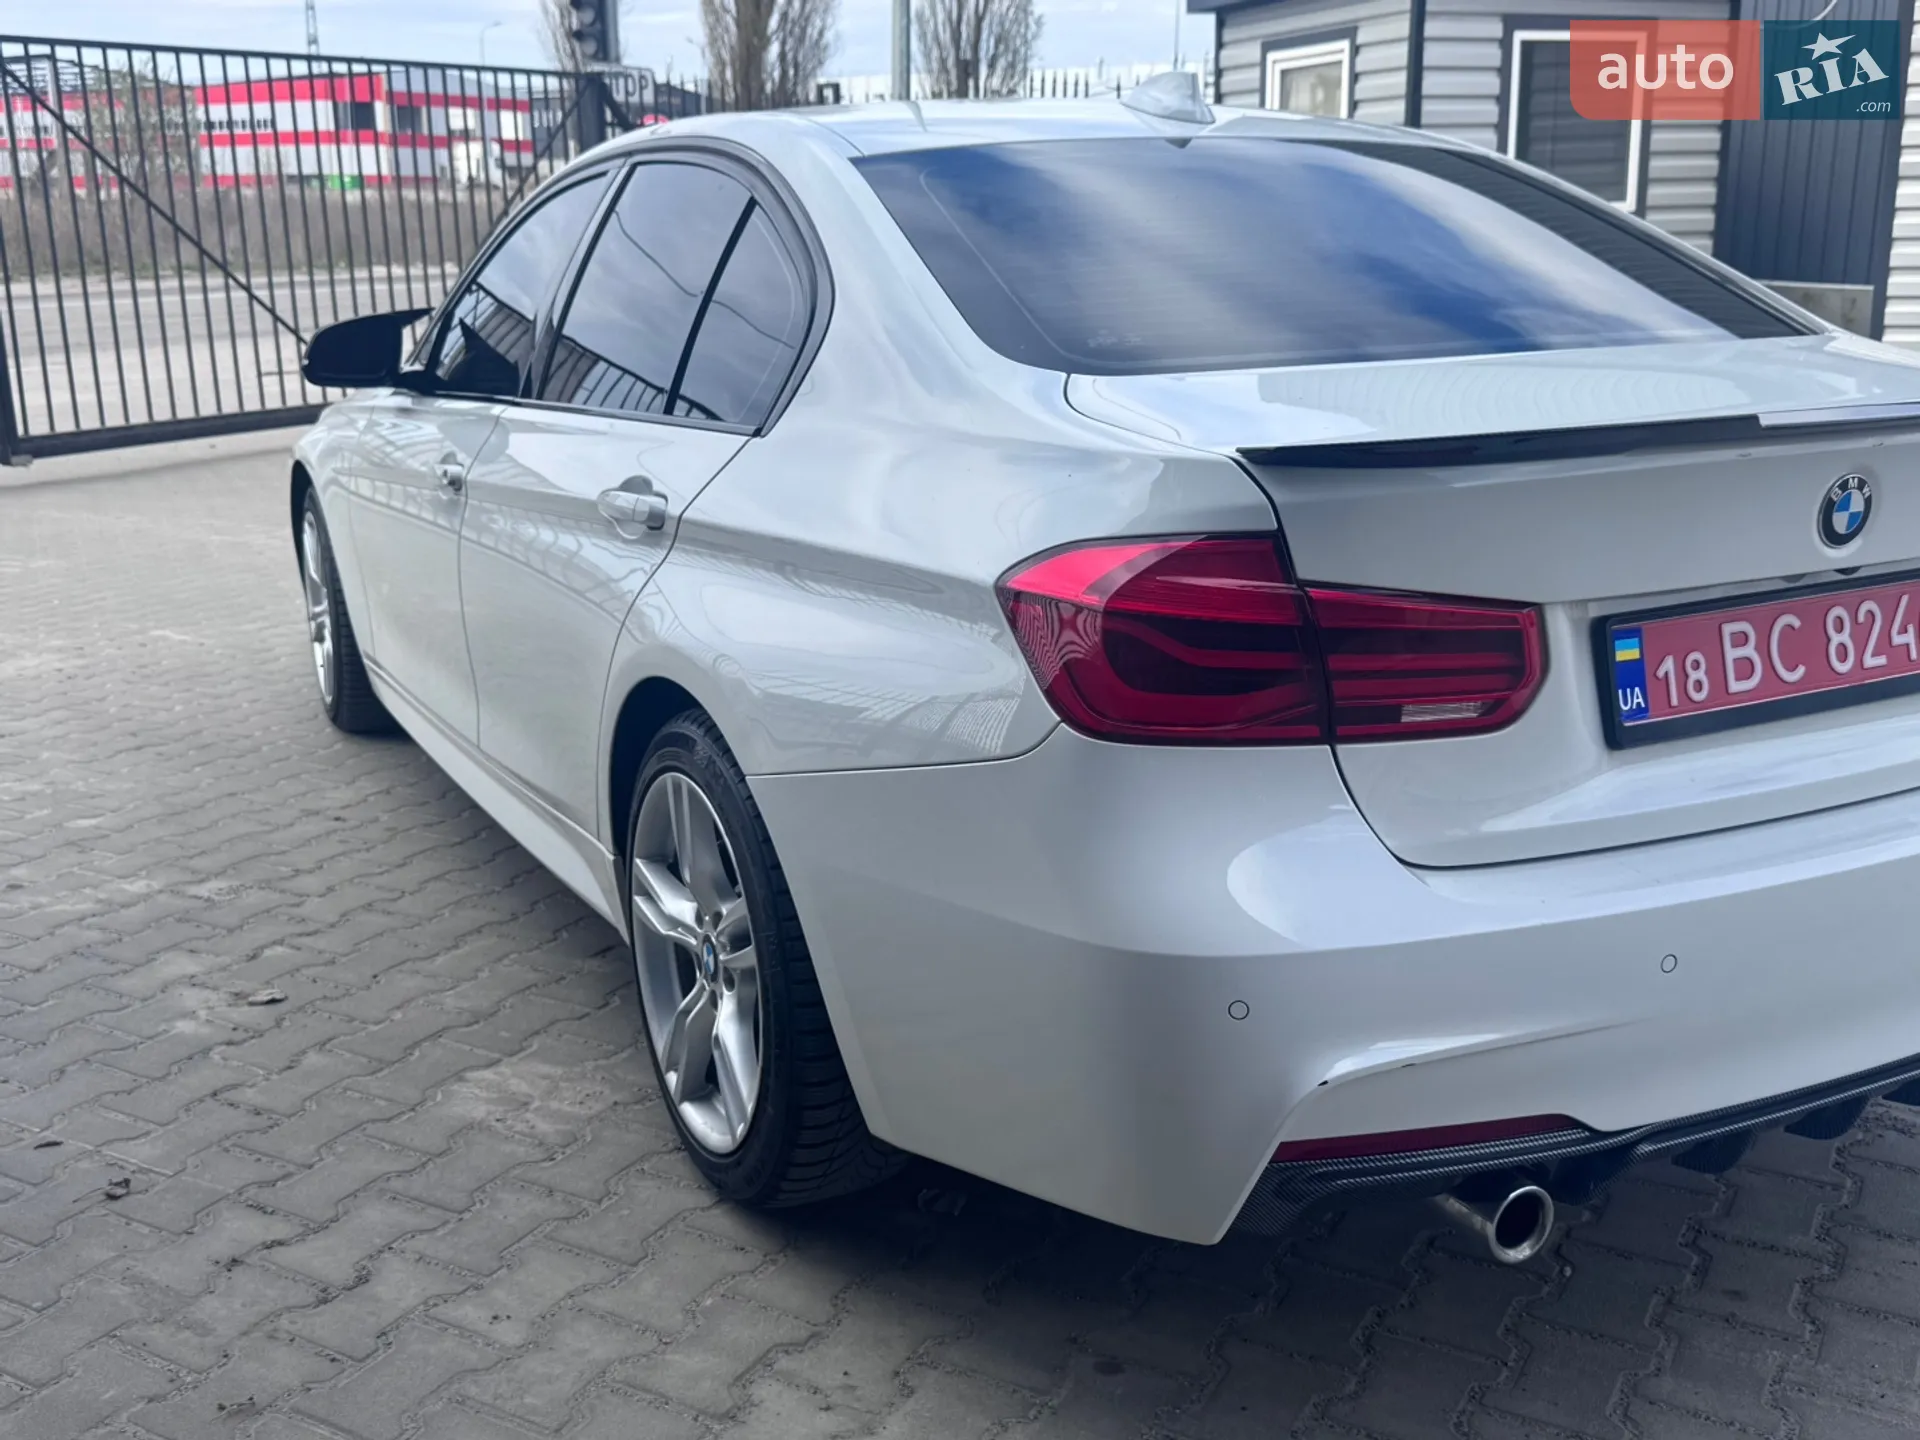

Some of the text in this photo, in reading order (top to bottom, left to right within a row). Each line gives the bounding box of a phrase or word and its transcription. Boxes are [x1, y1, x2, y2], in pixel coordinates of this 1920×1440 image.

[1830, 477, 1872, 502] BMW
[1655, 651, 1709, 707] 18
[1719, 613, 1806, 694] BC
[1618, 686, 1645, 711] UA
